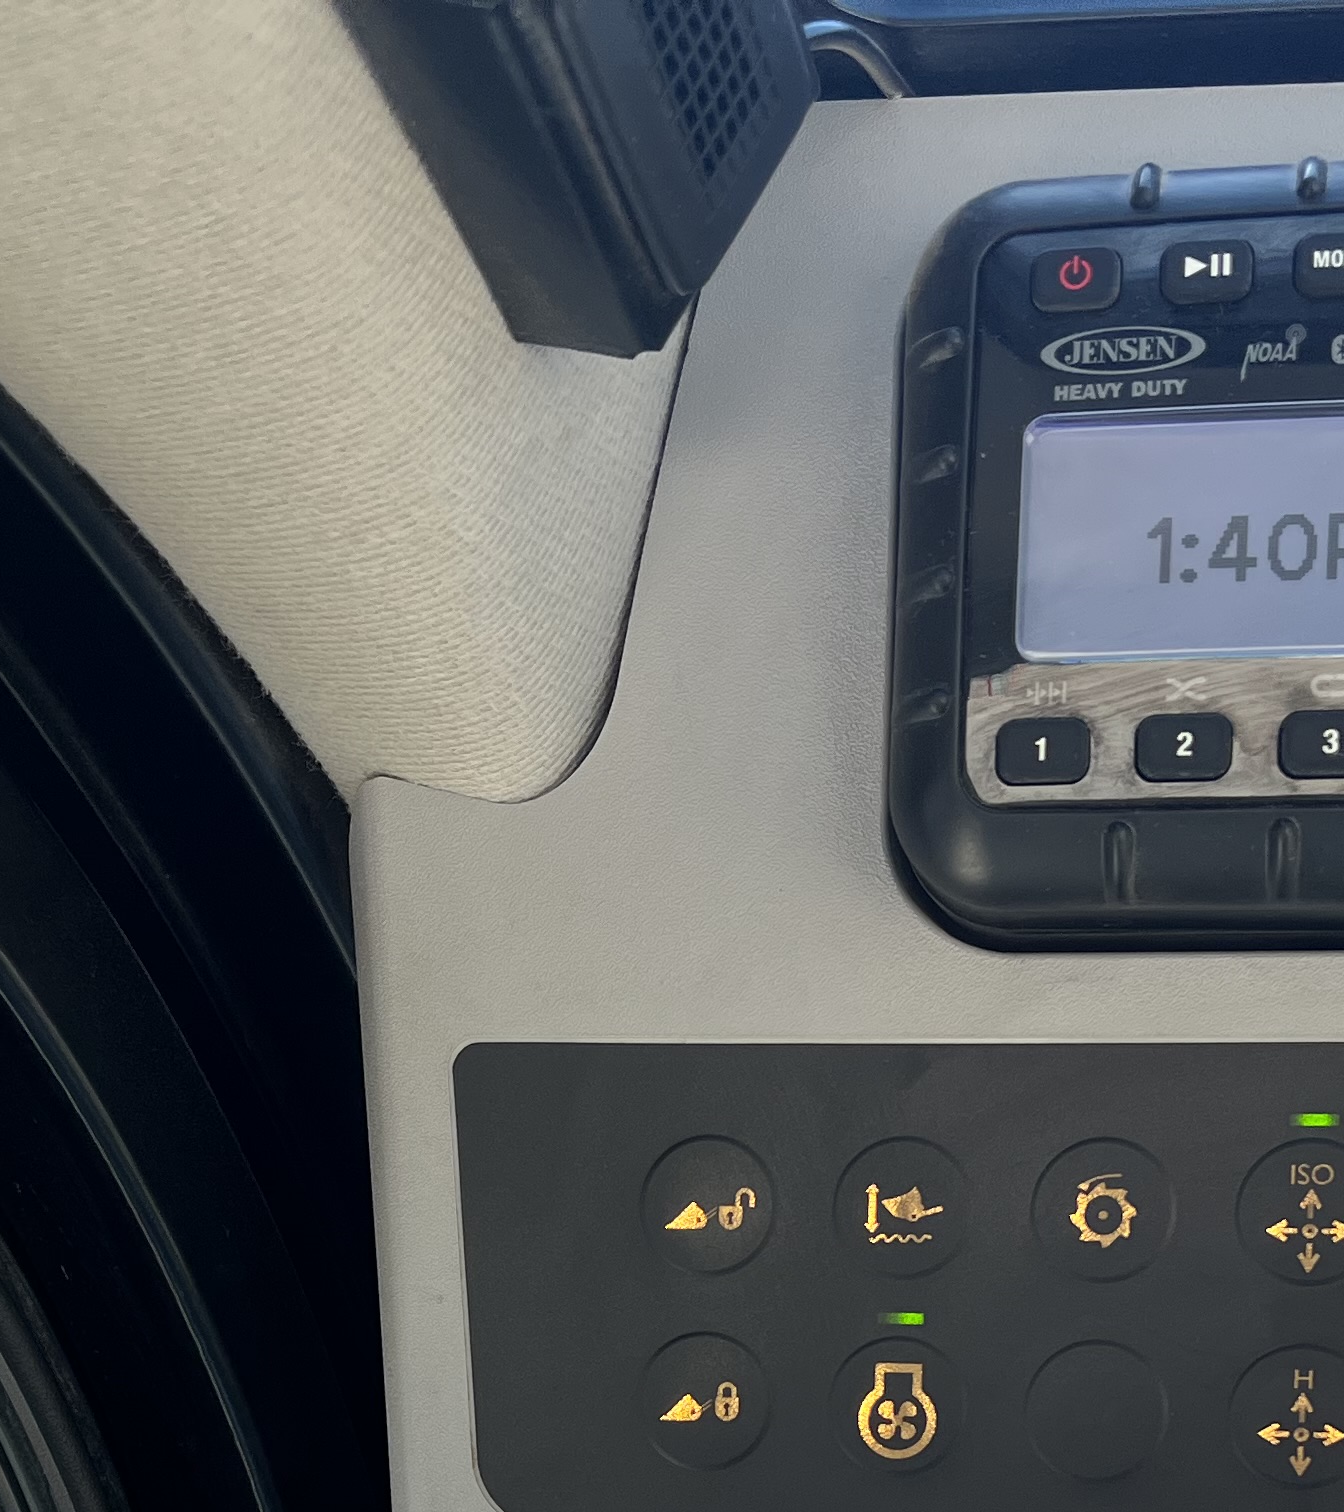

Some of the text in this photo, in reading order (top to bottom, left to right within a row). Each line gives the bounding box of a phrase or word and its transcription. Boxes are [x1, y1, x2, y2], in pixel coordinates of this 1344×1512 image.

[1064, 334, 1178, 365] JENSEN
[1240, 336, 1298, 383] NOAA
[1054, 378, 1189, 401] HEAVY DUTY
[1033, 736, 1048, 762] 1
[1175, 731, 1194, 758] 2
[1321, 728, 1341, 756] 3
[1290, 1163, 1336, 1186] ISO
[1293, 1368, 1315, 1390] H
